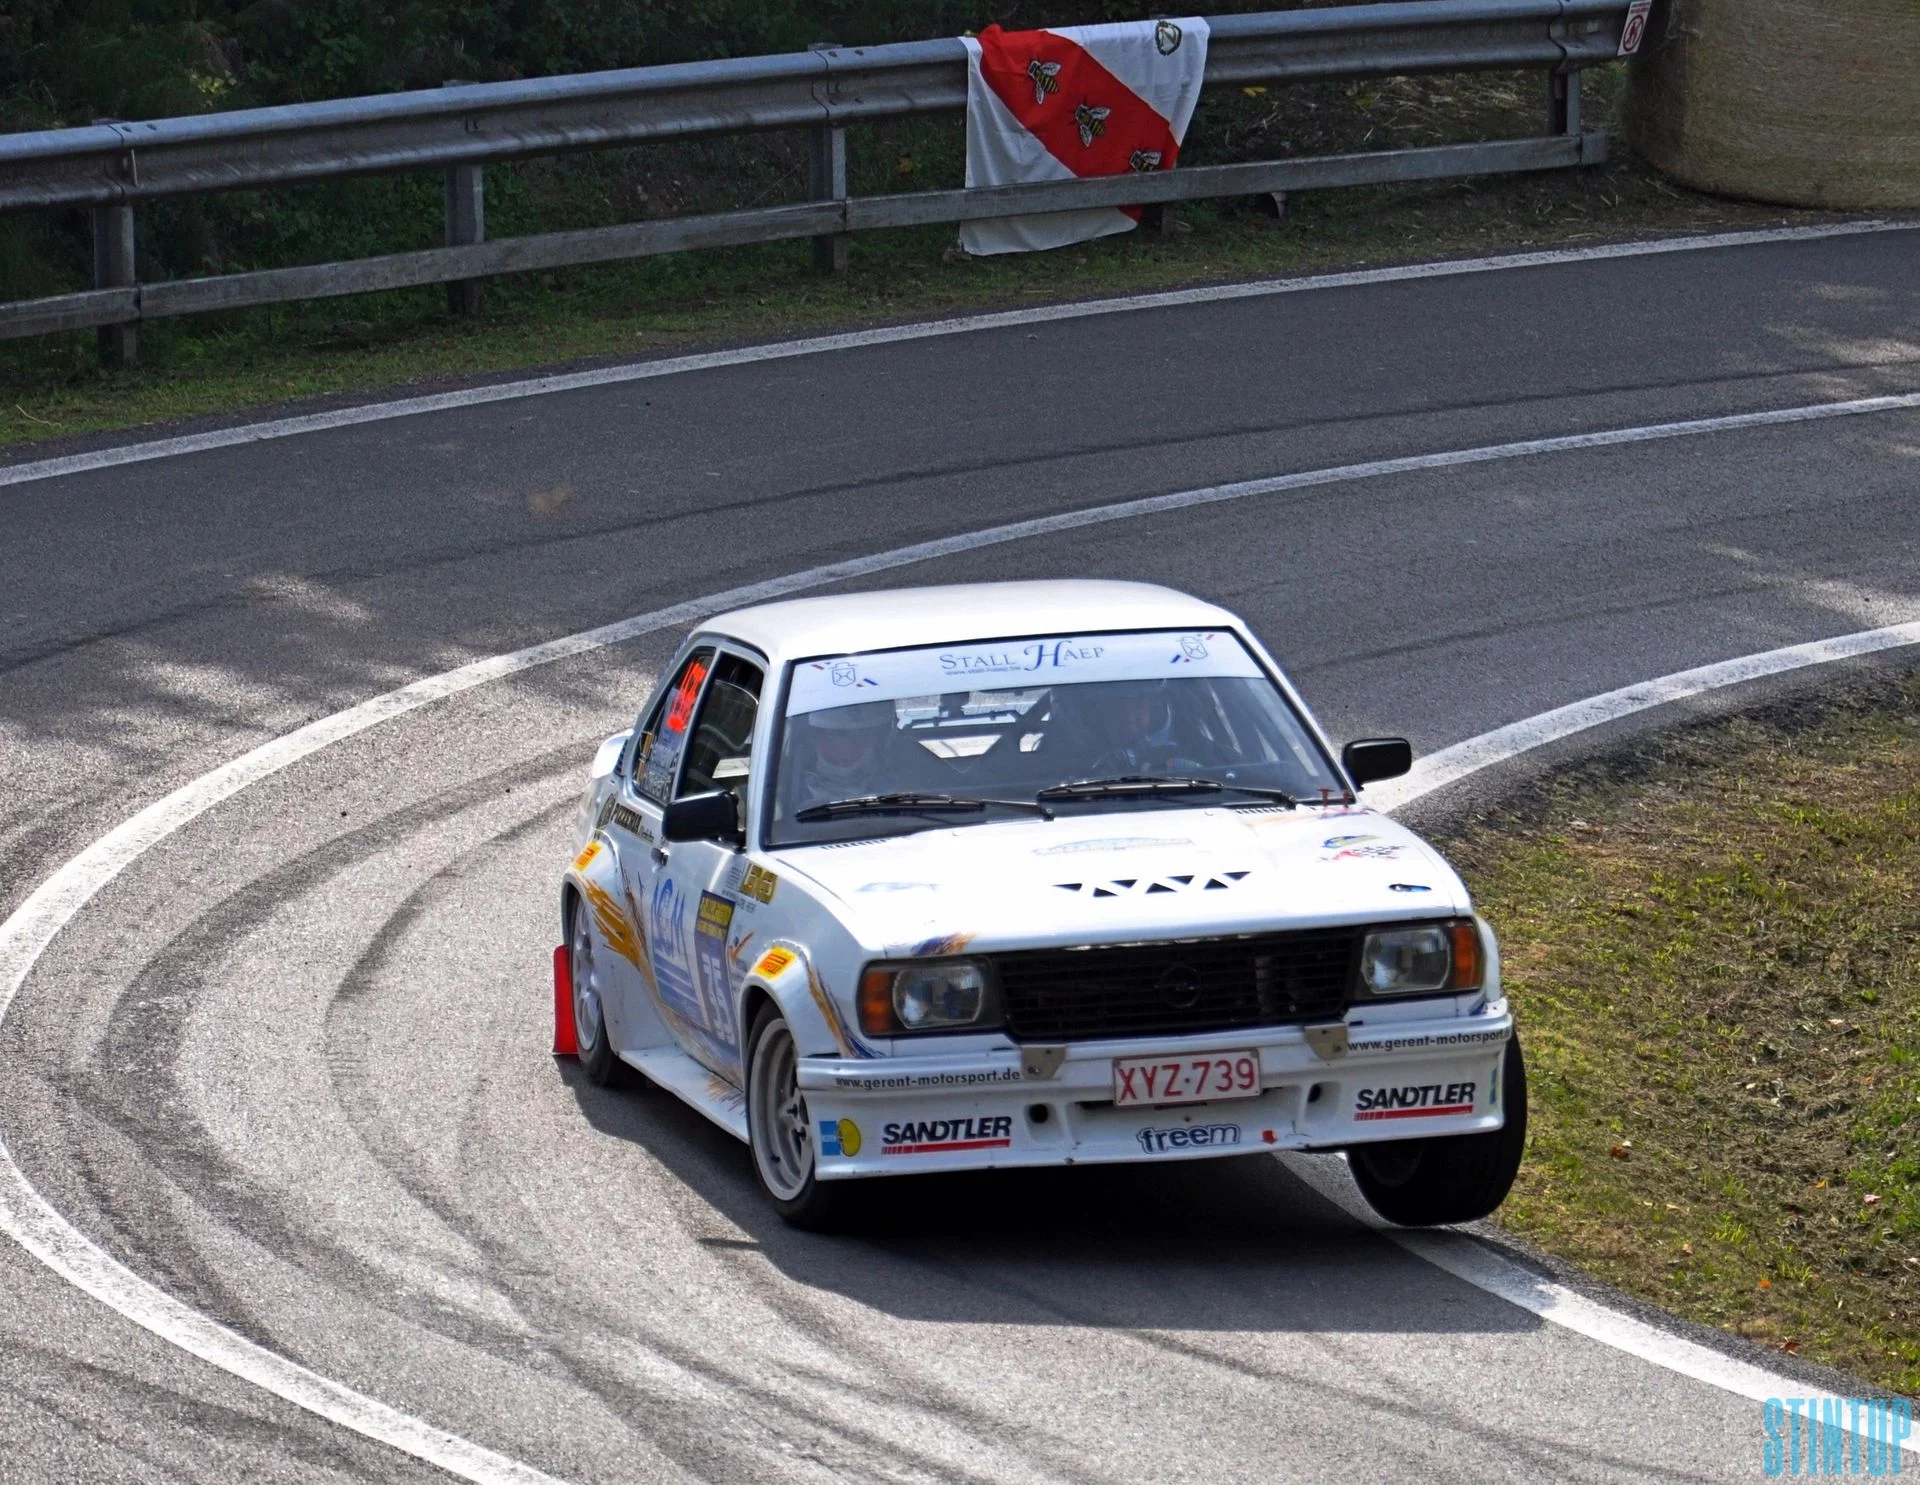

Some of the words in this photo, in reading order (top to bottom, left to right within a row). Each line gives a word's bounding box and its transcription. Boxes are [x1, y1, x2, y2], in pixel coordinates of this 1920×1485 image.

[835, 1068, 1020, 1091] www.gerent-motorsport.de
[1355, 1082, 1476, 1110] SANDTLER
[883, 1116, 1012, 1145] SANDTLER
[1141, 1126, 1238, 1153] freem
